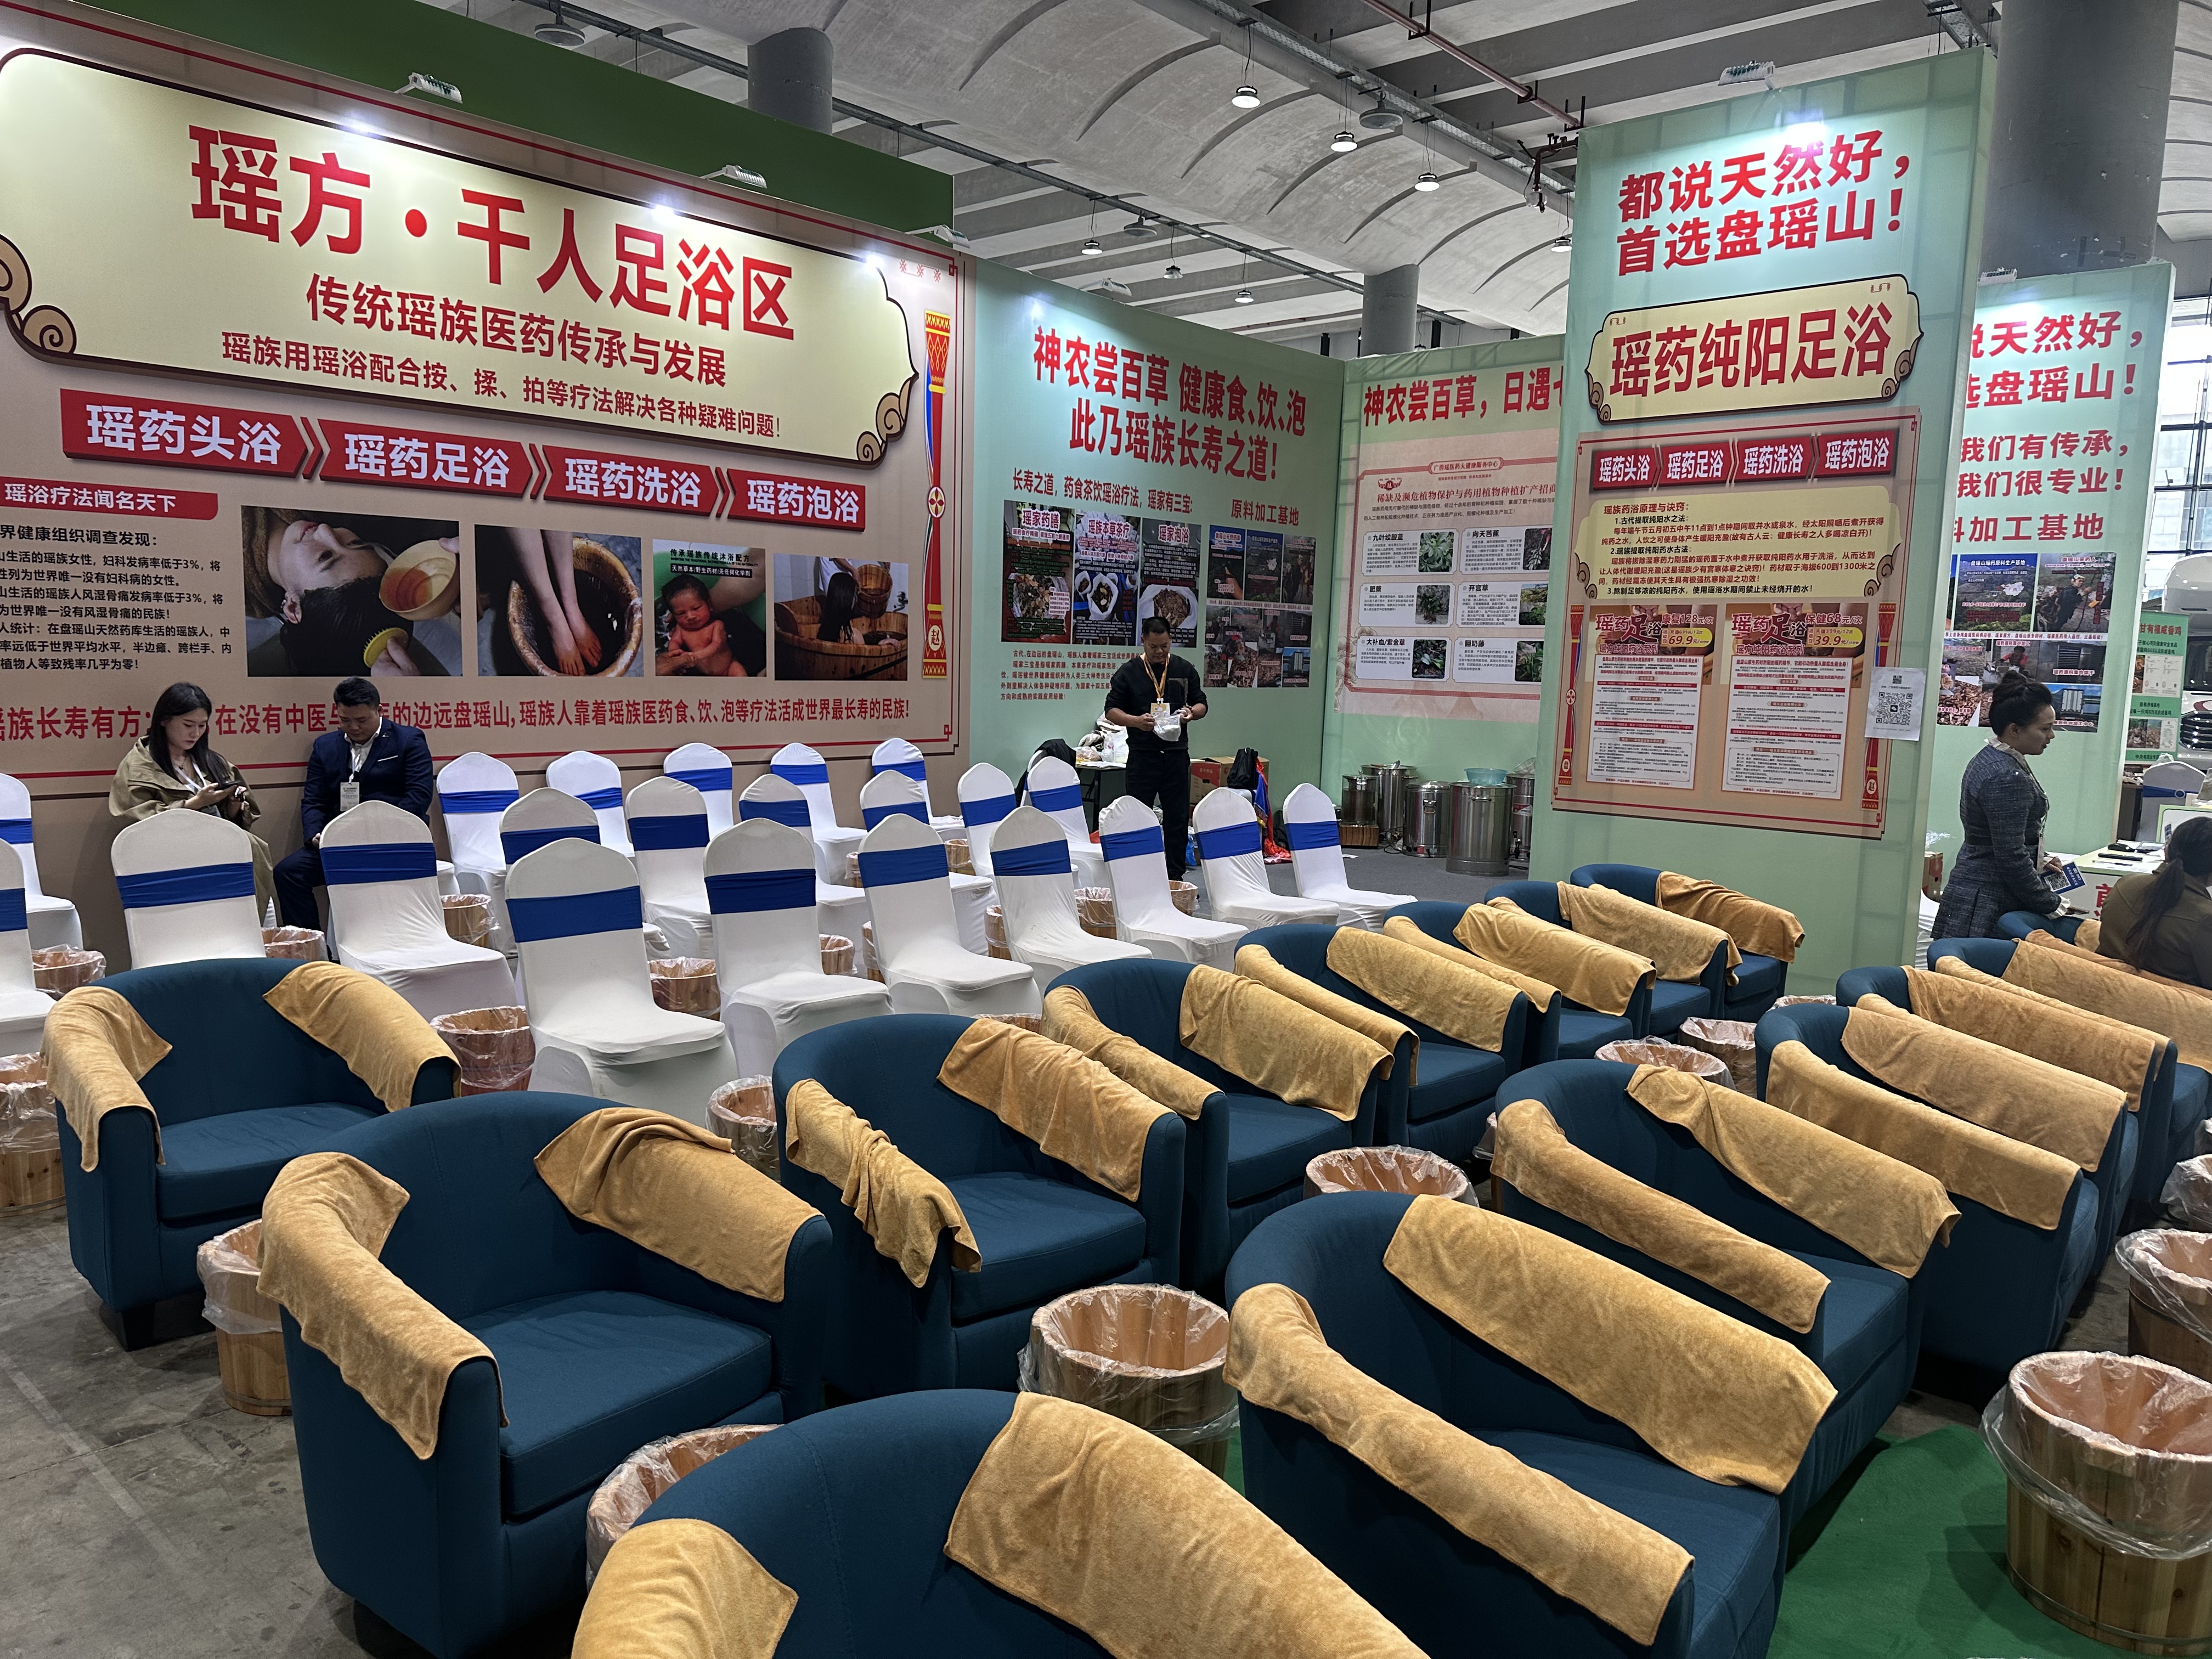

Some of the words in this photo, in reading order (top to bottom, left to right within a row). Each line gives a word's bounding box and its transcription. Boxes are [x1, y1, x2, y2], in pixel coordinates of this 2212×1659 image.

[1617, 129, 1911, 223] 都说天然好，
[1616, 188, 1903, 276] 首选盘瑶山！
[306, 273, 726, 388] 传统瑶族医药传承与发展
[1609, 301, 1893, 398] 瑶药纯阳足浴
[222, 330, 781, 438] 瑶族用瑶浴配合按、揉、拍等疗法解决各种疑难问题!
[1033, 325, 1169, 406] 神农尝百草
[1178, 362, 1306, 437] 健康食、饮、泡
[86, 403, 281, 465] 瑶药头浴
[1069, 397, 1278, 482] 此乃瑶族长寿之道！
[1961, 428, 2129, 463] 我们有传承，
[345, 432, 510, 489] 瑶药足浴
[1599, 453, 1650, 483] 瑶药头浴
[1667, 448, 1724, 481] 瑶药足浴
[1743, 443, 1804, 476] 瑶药洗浴
[1825, 437, 1890, 471] 瑶药泡浴
[4, 483, 176, 512] 瑶浴疗法闻名天下
[565, 458, 702, 509] 瑶药洗浴
[1957, 467, 2124, 499] 我们很专业！
[747, 479, 860, 523] 瑶药泡浴
[1231, 499, 1300, 526] 原料加工基地
[1603, 502, 1689, 515] 瑶族药浴原理与诀窍：
[1088, 520, 1130, 539] 瑶族本草茶疗
[1158, 524, 1190, 544] 瑶家泡浴
[1595, 613, 1662, 644] 瑶药足浴
[1731, 612, 1807, 645] 瑶药足浴
[1805, 613, 1863, 625] 保健68元/次
[930, 629, 940, 646] 赵
[1736, 644, 1805, 656] 瑶方纯阳药浴系列
